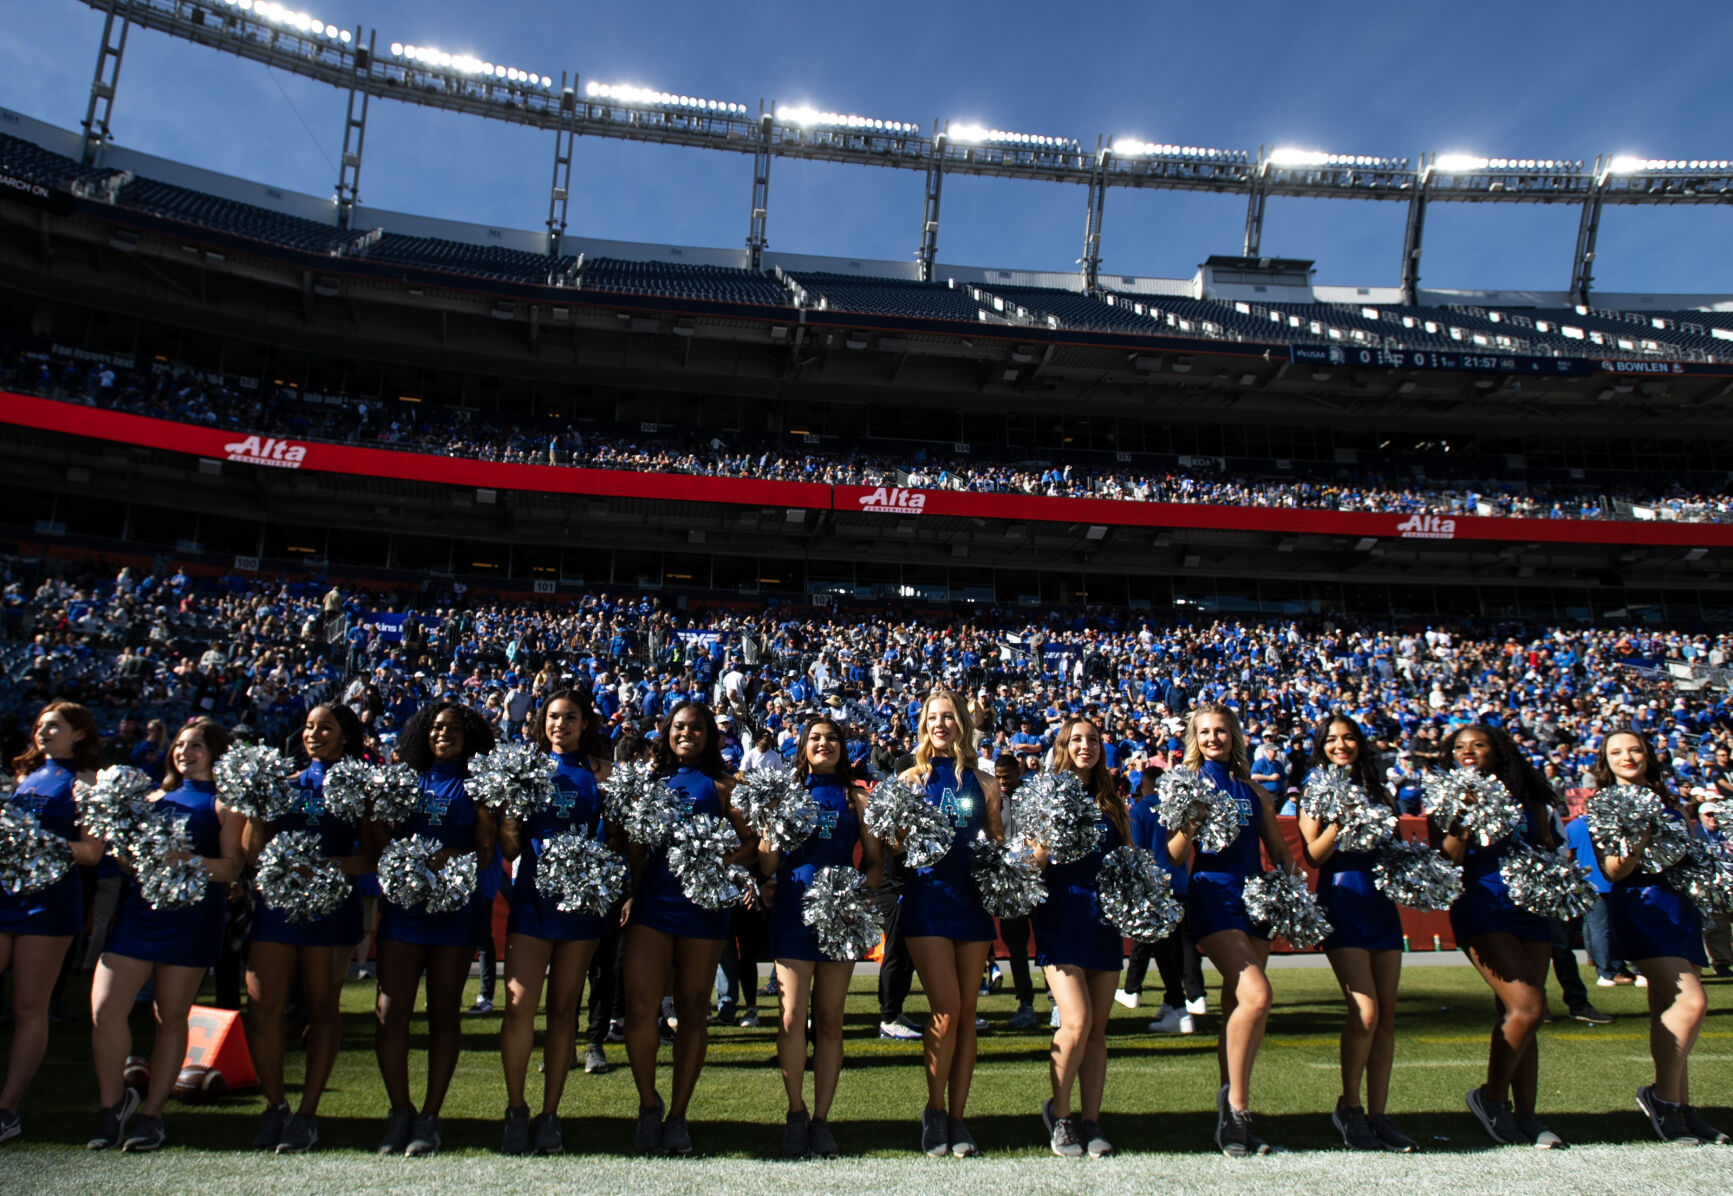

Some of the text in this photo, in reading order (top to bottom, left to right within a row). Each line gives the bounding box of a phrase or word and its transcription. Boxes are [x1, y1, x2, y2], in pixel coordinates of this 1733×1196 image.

[0, 174, 32, 192] ARCH
[1359, 350, 1371, 363] 0
[1413, 352, 1426, 366] 0
[1463, 356, 1497, 369] 21:57
[1616, 361, 1669, 373] BOWLEN
[224, 435, 307, 462] Alta
[859, 487, 926, 508] Alta
[1396, 514, 1456, 533] Alta
[237, 557, 257, 569] 100
[536, 580, 553, 592] 101
[939, 781, 974, 828] AF
